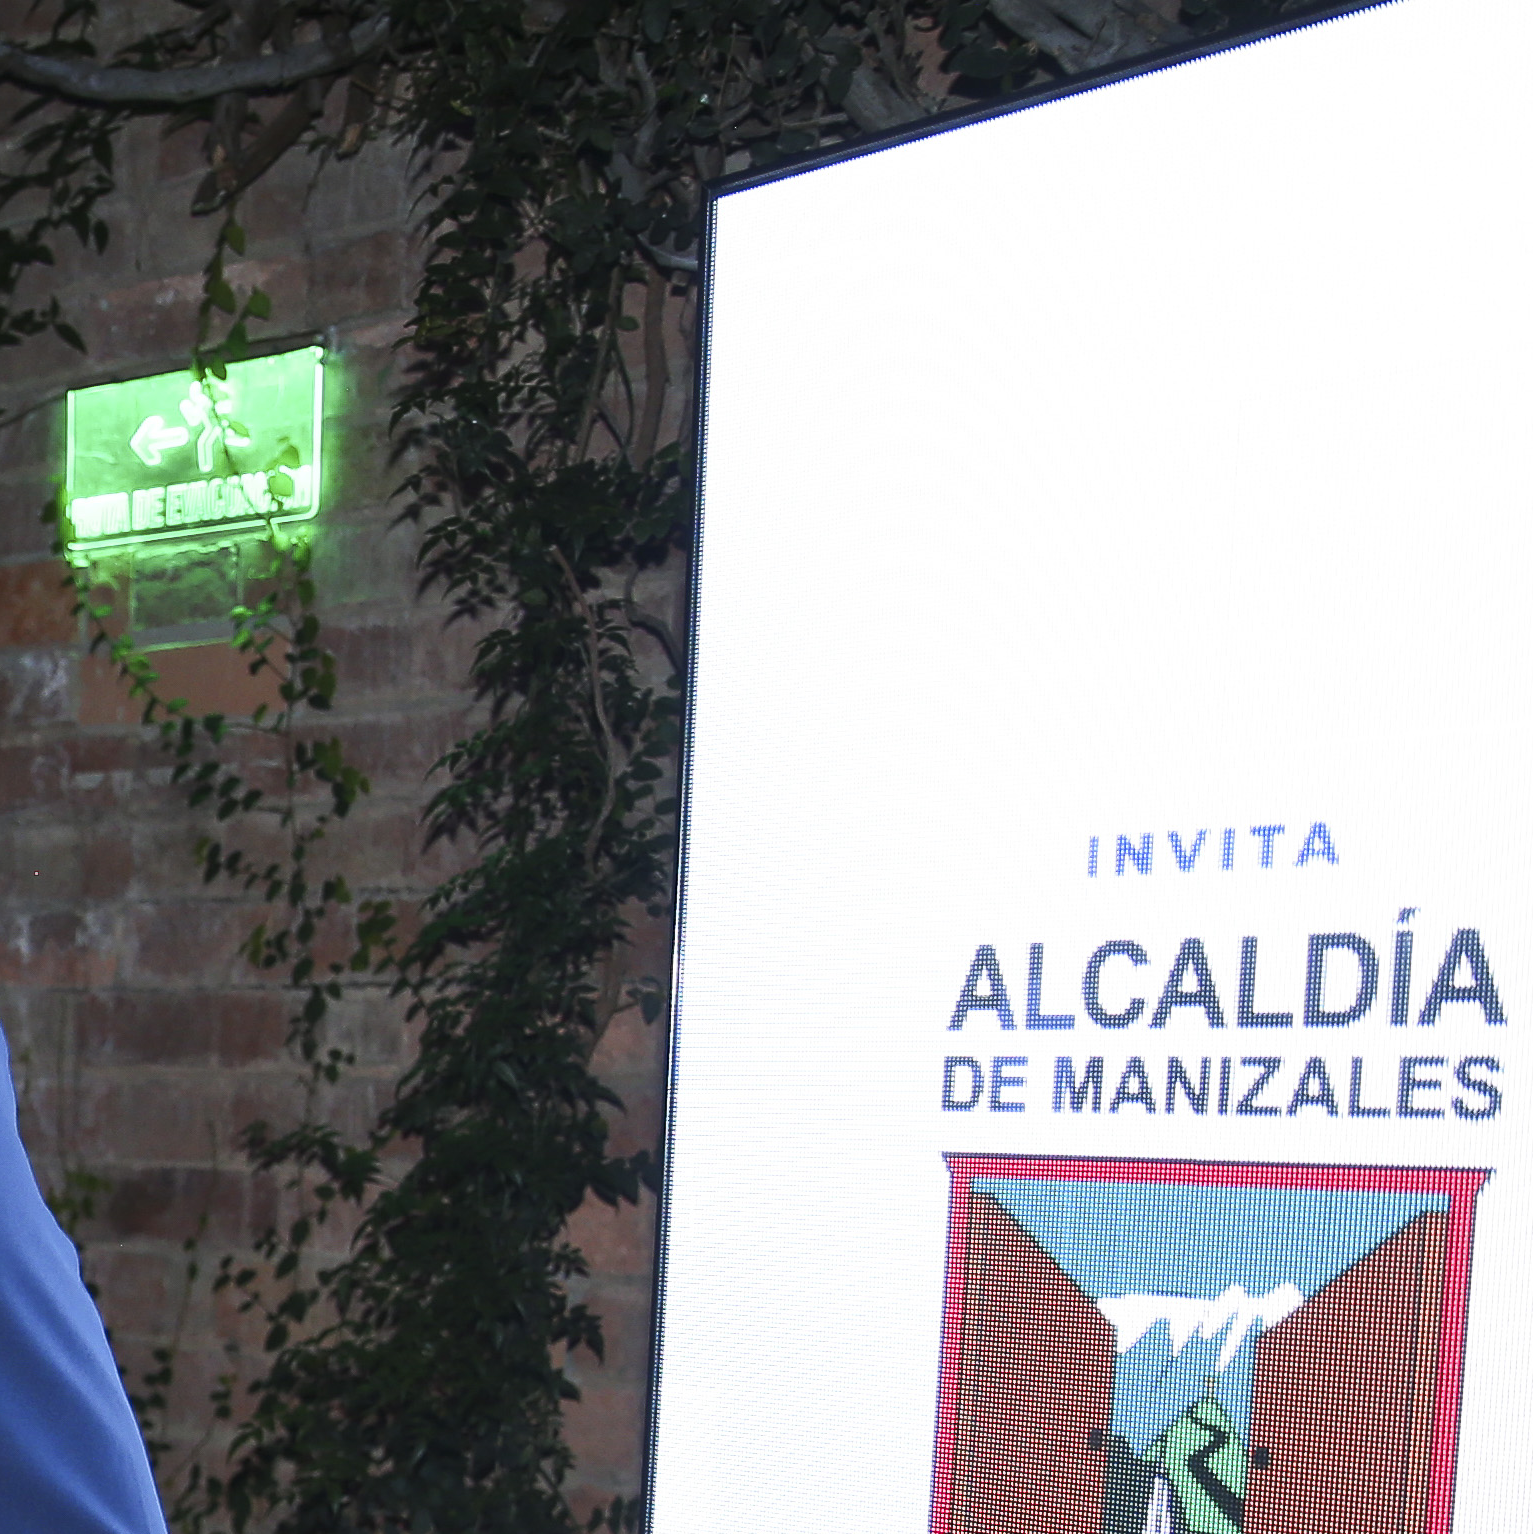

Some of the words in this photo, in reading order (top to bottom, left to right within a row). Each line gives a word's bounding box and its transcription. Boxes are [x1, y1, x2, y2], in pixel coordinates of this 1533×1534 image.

[1087, 822, 1339, 877] INVITA
[947, 906, 1508, 1032] ALCALDÍA
[940, 1055, 1029, 1113] DE
[1051, 1055, 1504, 1122] MANIZALES
